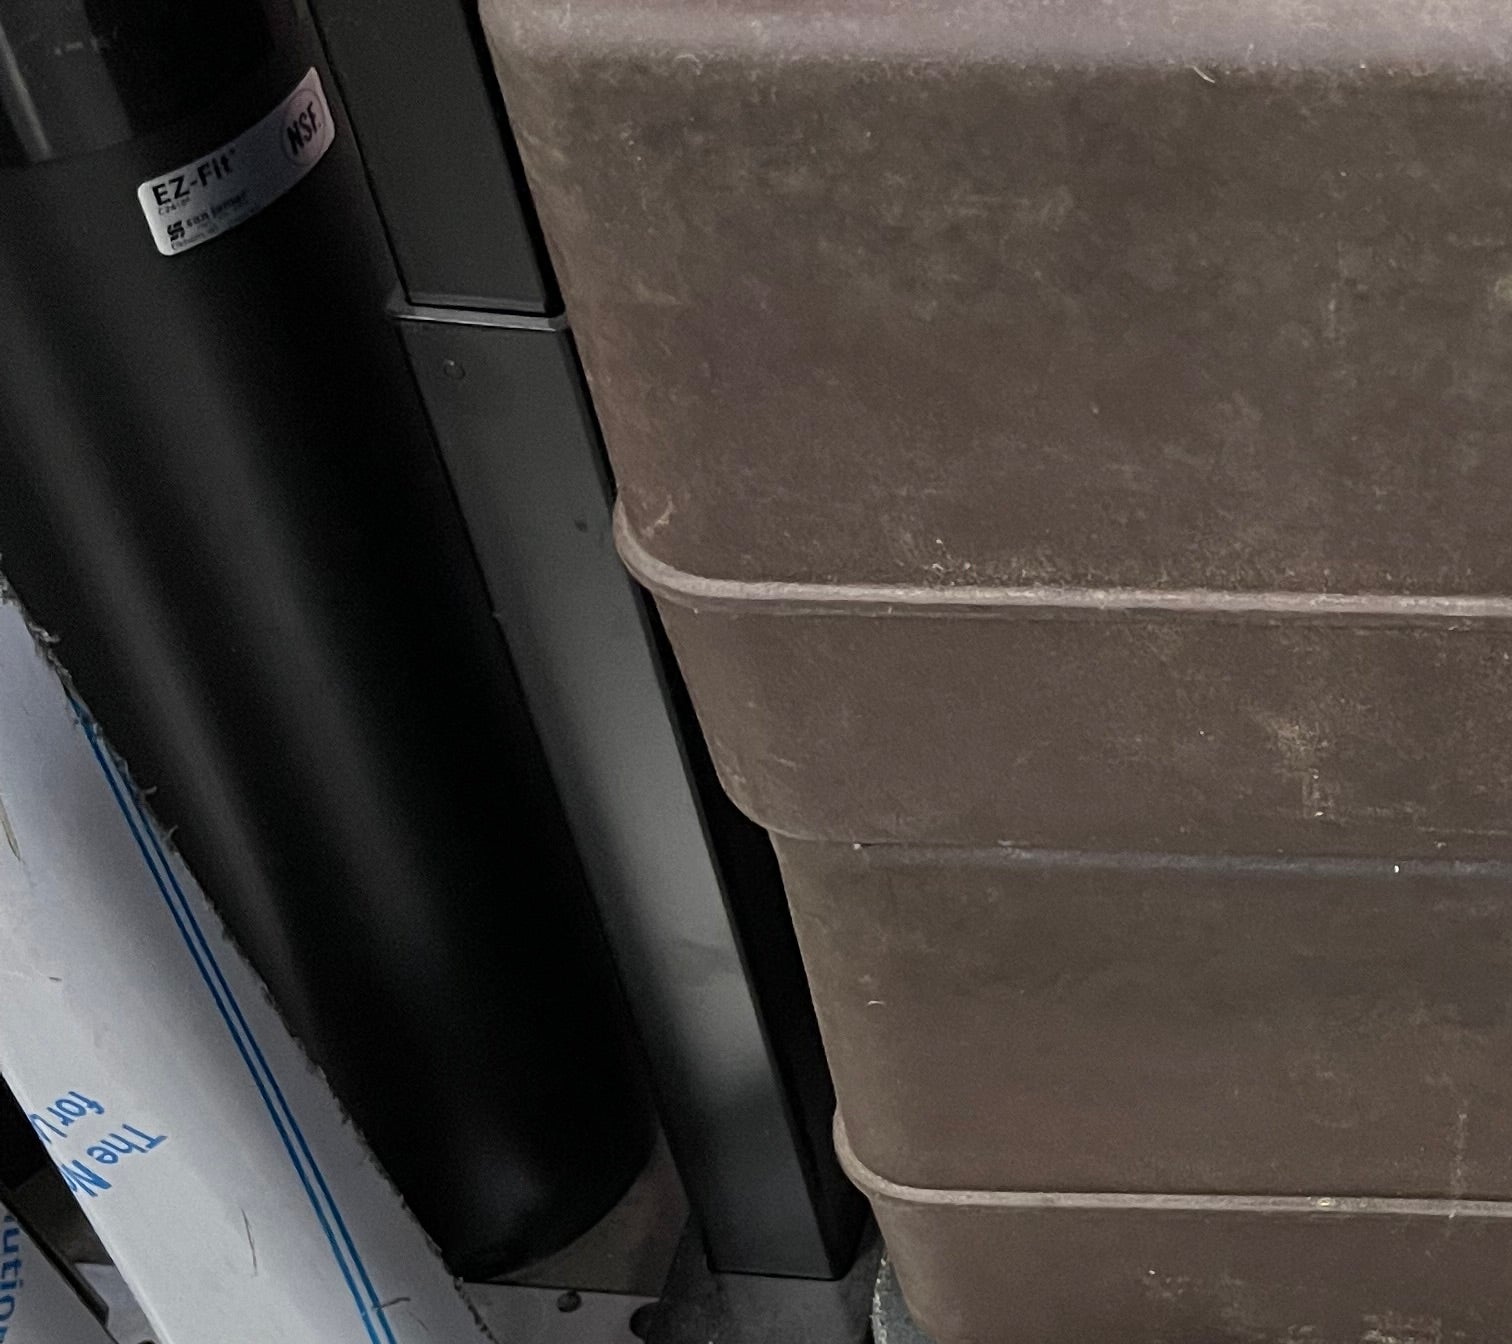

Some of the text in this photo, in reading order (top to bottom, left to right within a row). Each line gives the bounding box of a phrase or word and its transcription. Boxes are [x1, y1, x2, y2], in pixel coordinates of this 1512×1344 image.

[286, 101, 319, 155] NSF
[46, 1090, 105, 1126] for
[86, 1123, 168, 1164] The
